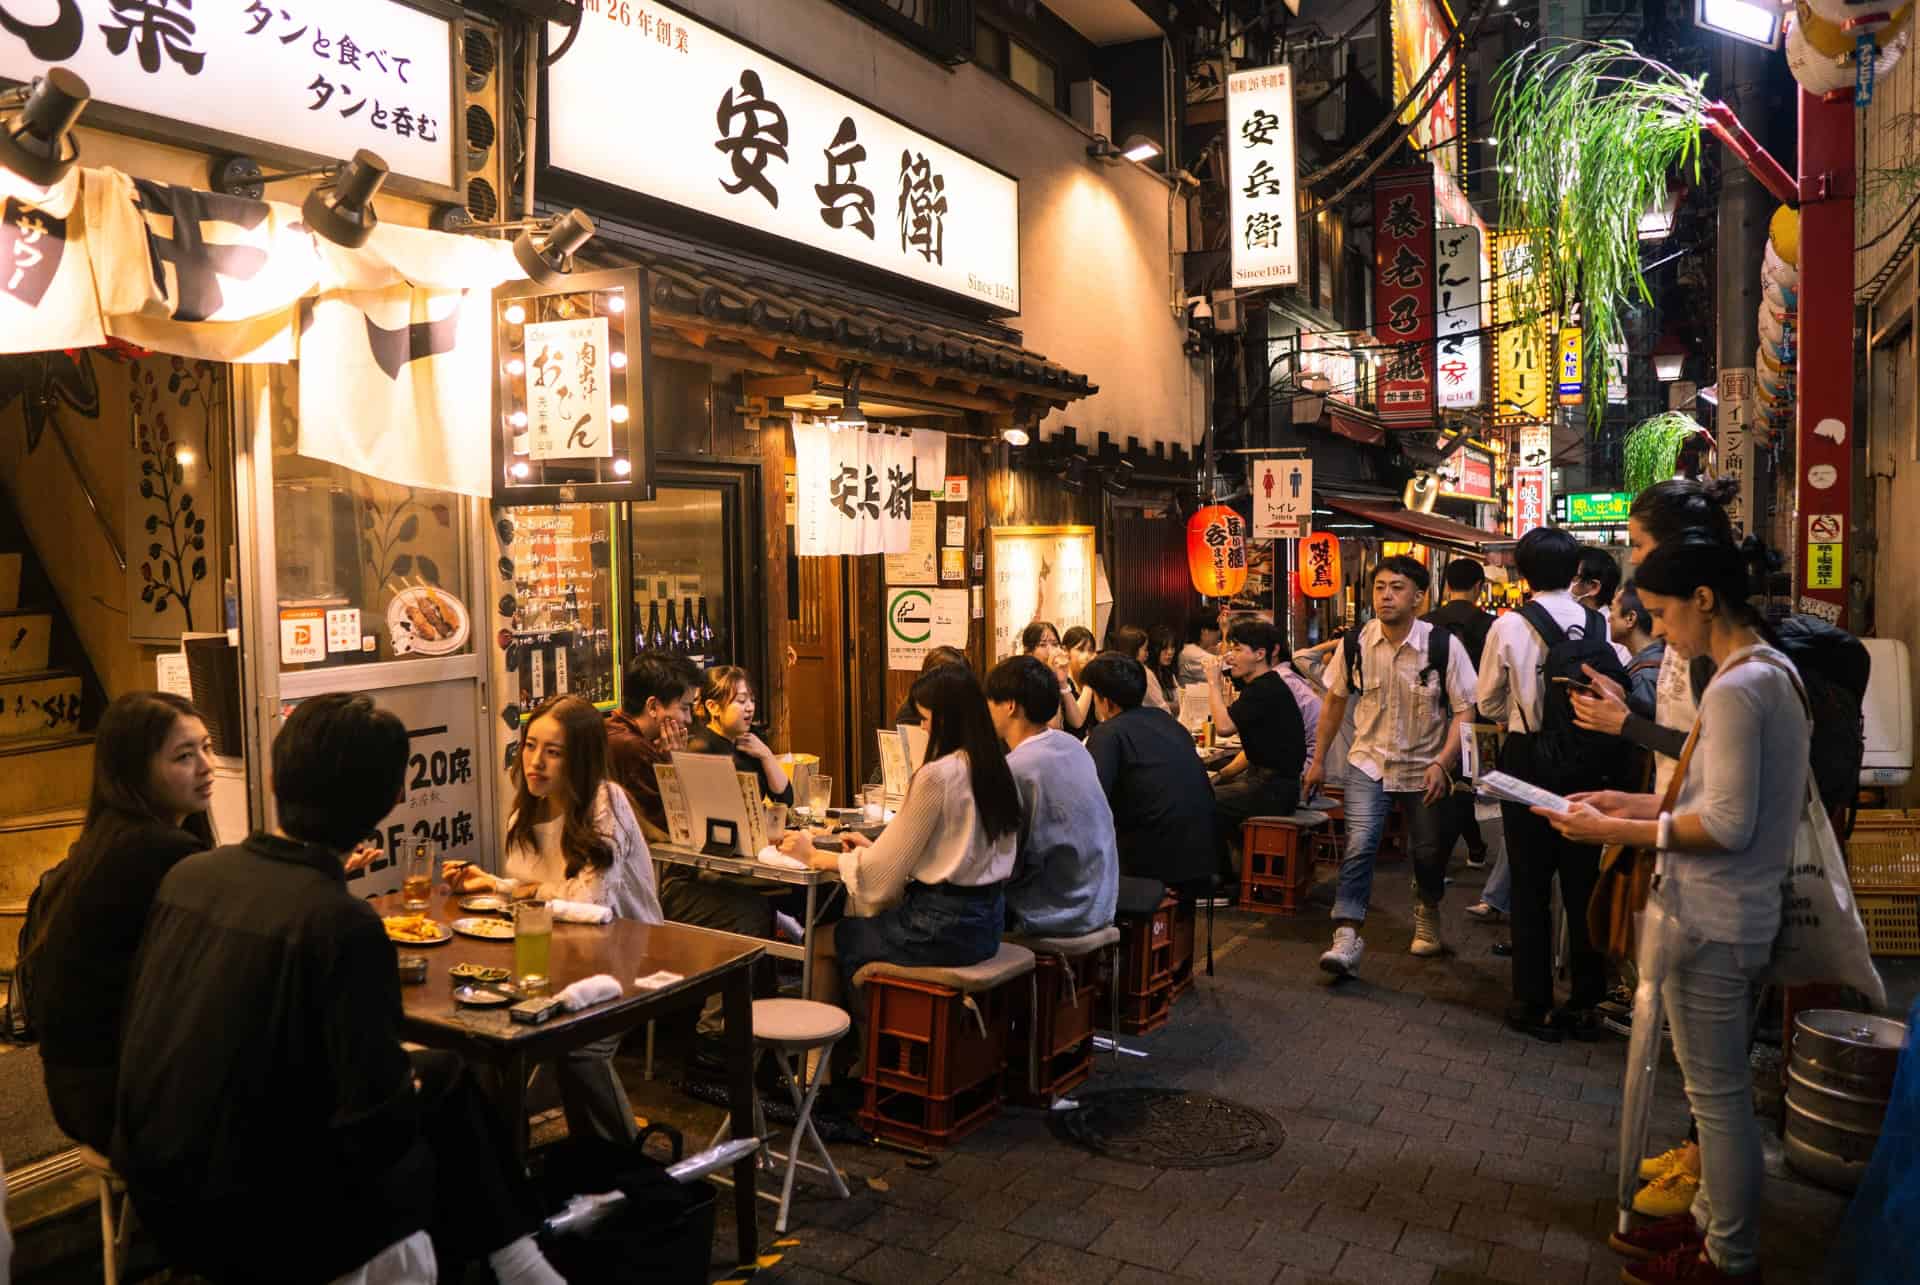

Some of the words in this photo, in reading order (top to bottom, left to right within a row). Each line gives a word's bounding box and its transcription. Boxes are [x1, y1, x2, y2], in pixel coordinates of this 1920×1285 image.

[244, 0, 412, 84] タンと食べて
[307, 73, 437, 142] タンと呑む
[714, 69, 948, 266] 安兵衛
[1241, 109, 1283, 250] 安兵衛
[968, 272, 992, 296] Since
[995, 282, 1014, 303] 1951
[1267, 503, 1297, 513] トイレ
[409, 748, 471, 790] 20席
